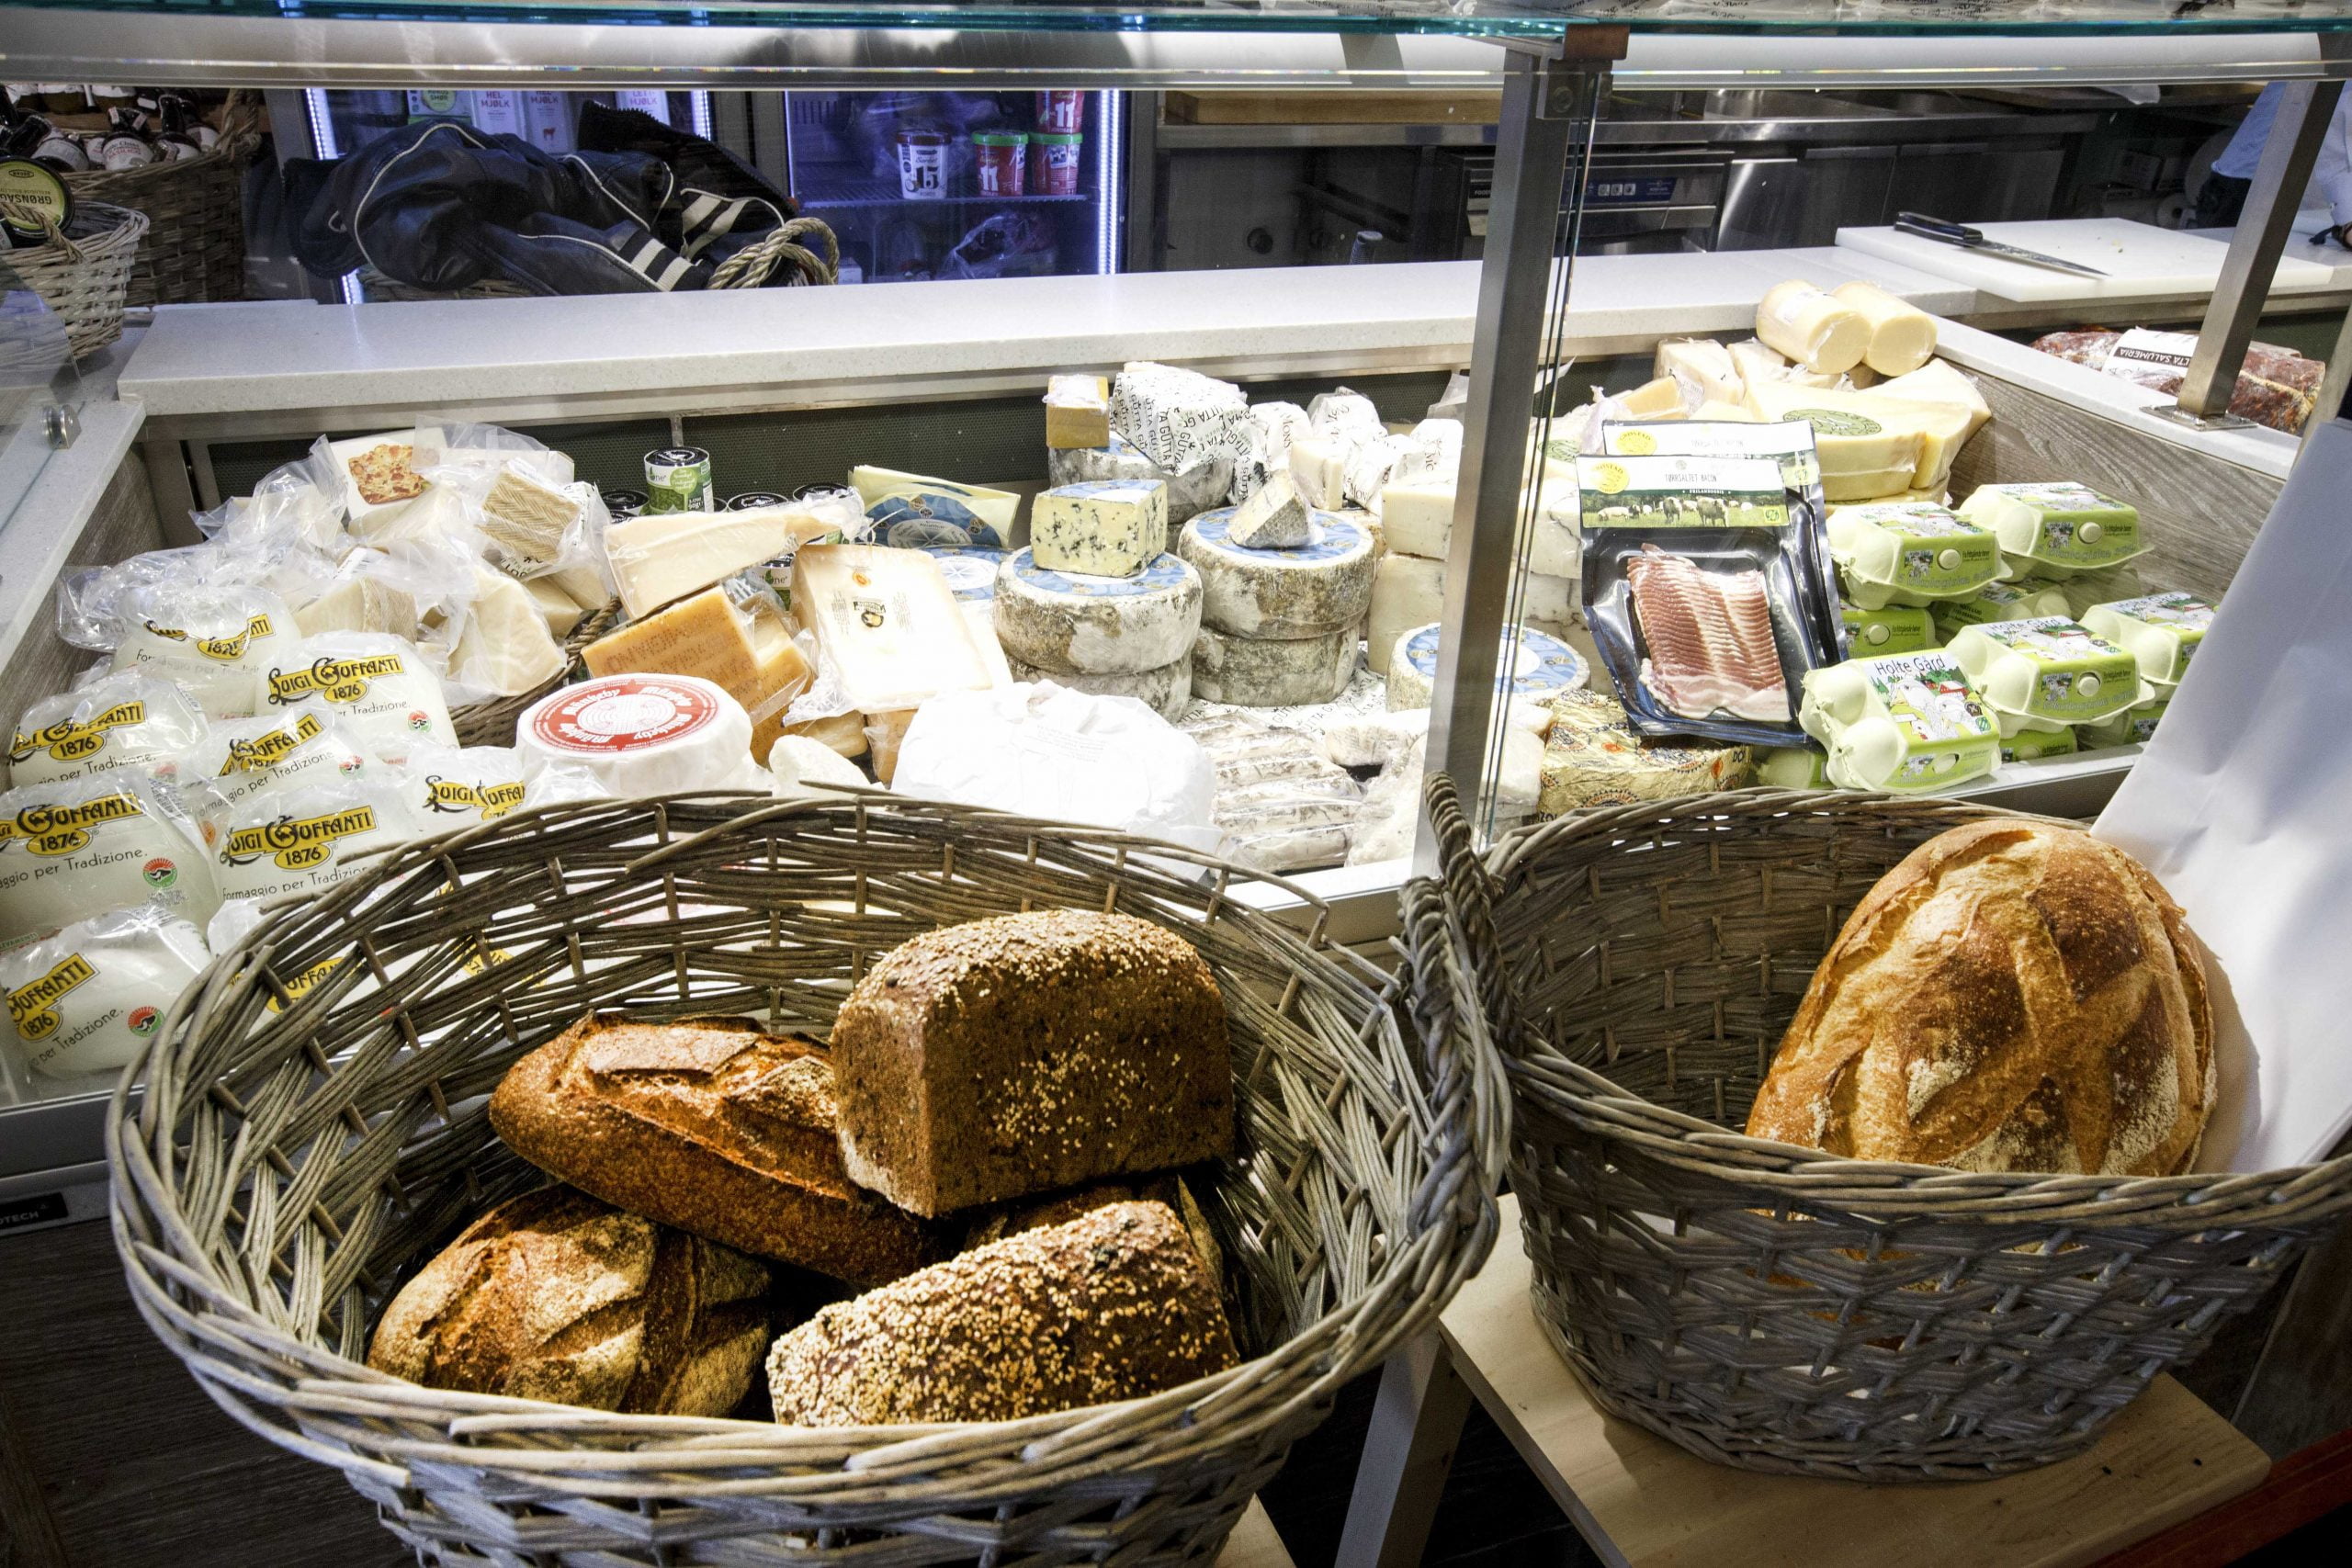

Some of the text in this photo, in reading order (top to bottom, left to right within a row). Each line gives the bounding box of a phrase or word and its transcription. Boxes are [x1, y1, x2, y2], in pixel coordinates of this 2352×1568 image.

[481, 99, 511, 108] MJØLK
[530, 96, 560, 104] MJØLK
[1055, 102, 1075, 128] 11
[916, 165, 939, 189] 15
[979, 166, 999, 192] 11
[2119, 347, 2172, 365] SALUMERIA
[1145, 397, 1153, 426] UTTA
[1159, 425, 1172, 461] GUTTA
[1874, 654, 1946, 676] Holte Gård
[268, 657, 400, 705] LUIGI GUFFANTI
[333, 684, 361, 700] 1876
[59, 737, 96, 758] 1876
[84, 753, 157, 775] Tradizione.
[248, 776, 270, 794] per
[17, 798, 138, 835] GUFFANTI
[39, 832, 82, 852] 1876
[265, 815, 371, 850] GUFFANTI
[35, 863, 60, 880] per
[64, 847, 149, 872] Tradizione.
[285, 847, 322, 866] 1876
[282, 880, 304, 894] per
[22, 1013, 54, 1038] 1876
[52, 1008, 125, 1050] Tradizione.
